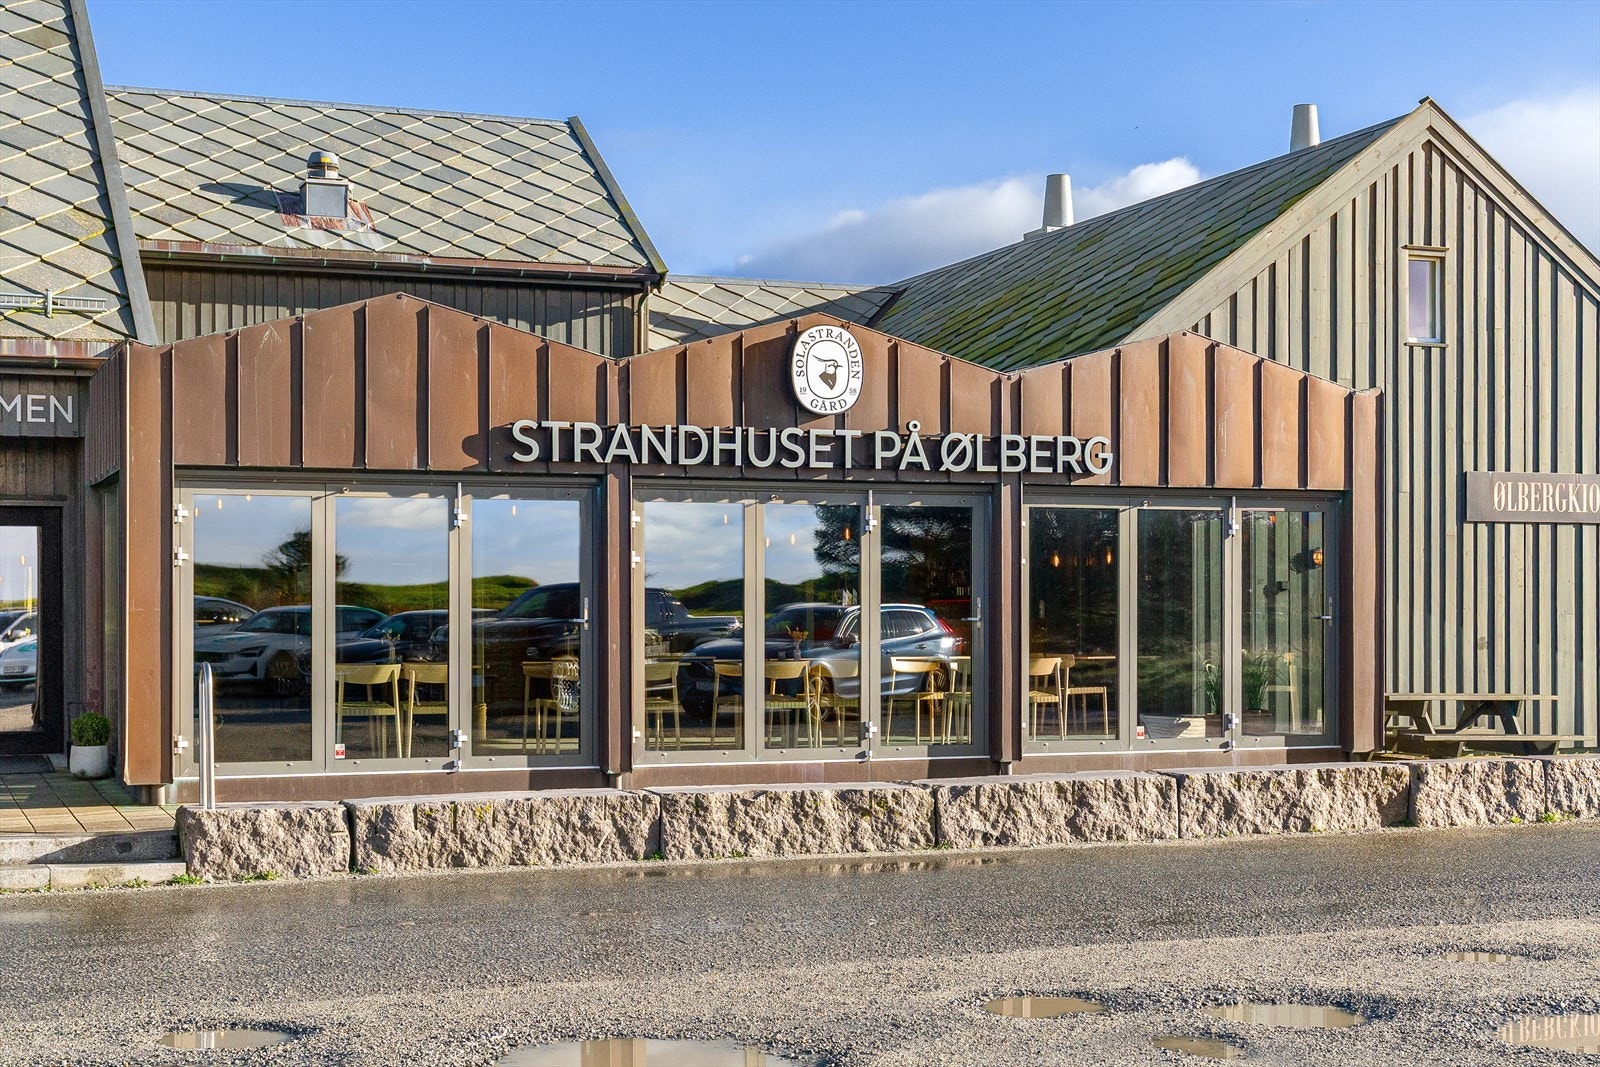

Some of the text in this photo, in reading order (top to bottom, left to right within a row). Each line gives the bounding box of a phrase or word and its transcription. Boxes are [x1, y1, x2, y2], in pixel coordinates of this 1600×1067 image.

[796, 329, 860, 380] SOLASTRANDEN
[810, 398, 847, 412] GÅRD
[511, 419, 1114, 475] STRANDHUSET PÅ ØLBERG
[1493, 481, 1600, 513] ØLBERGKIO
